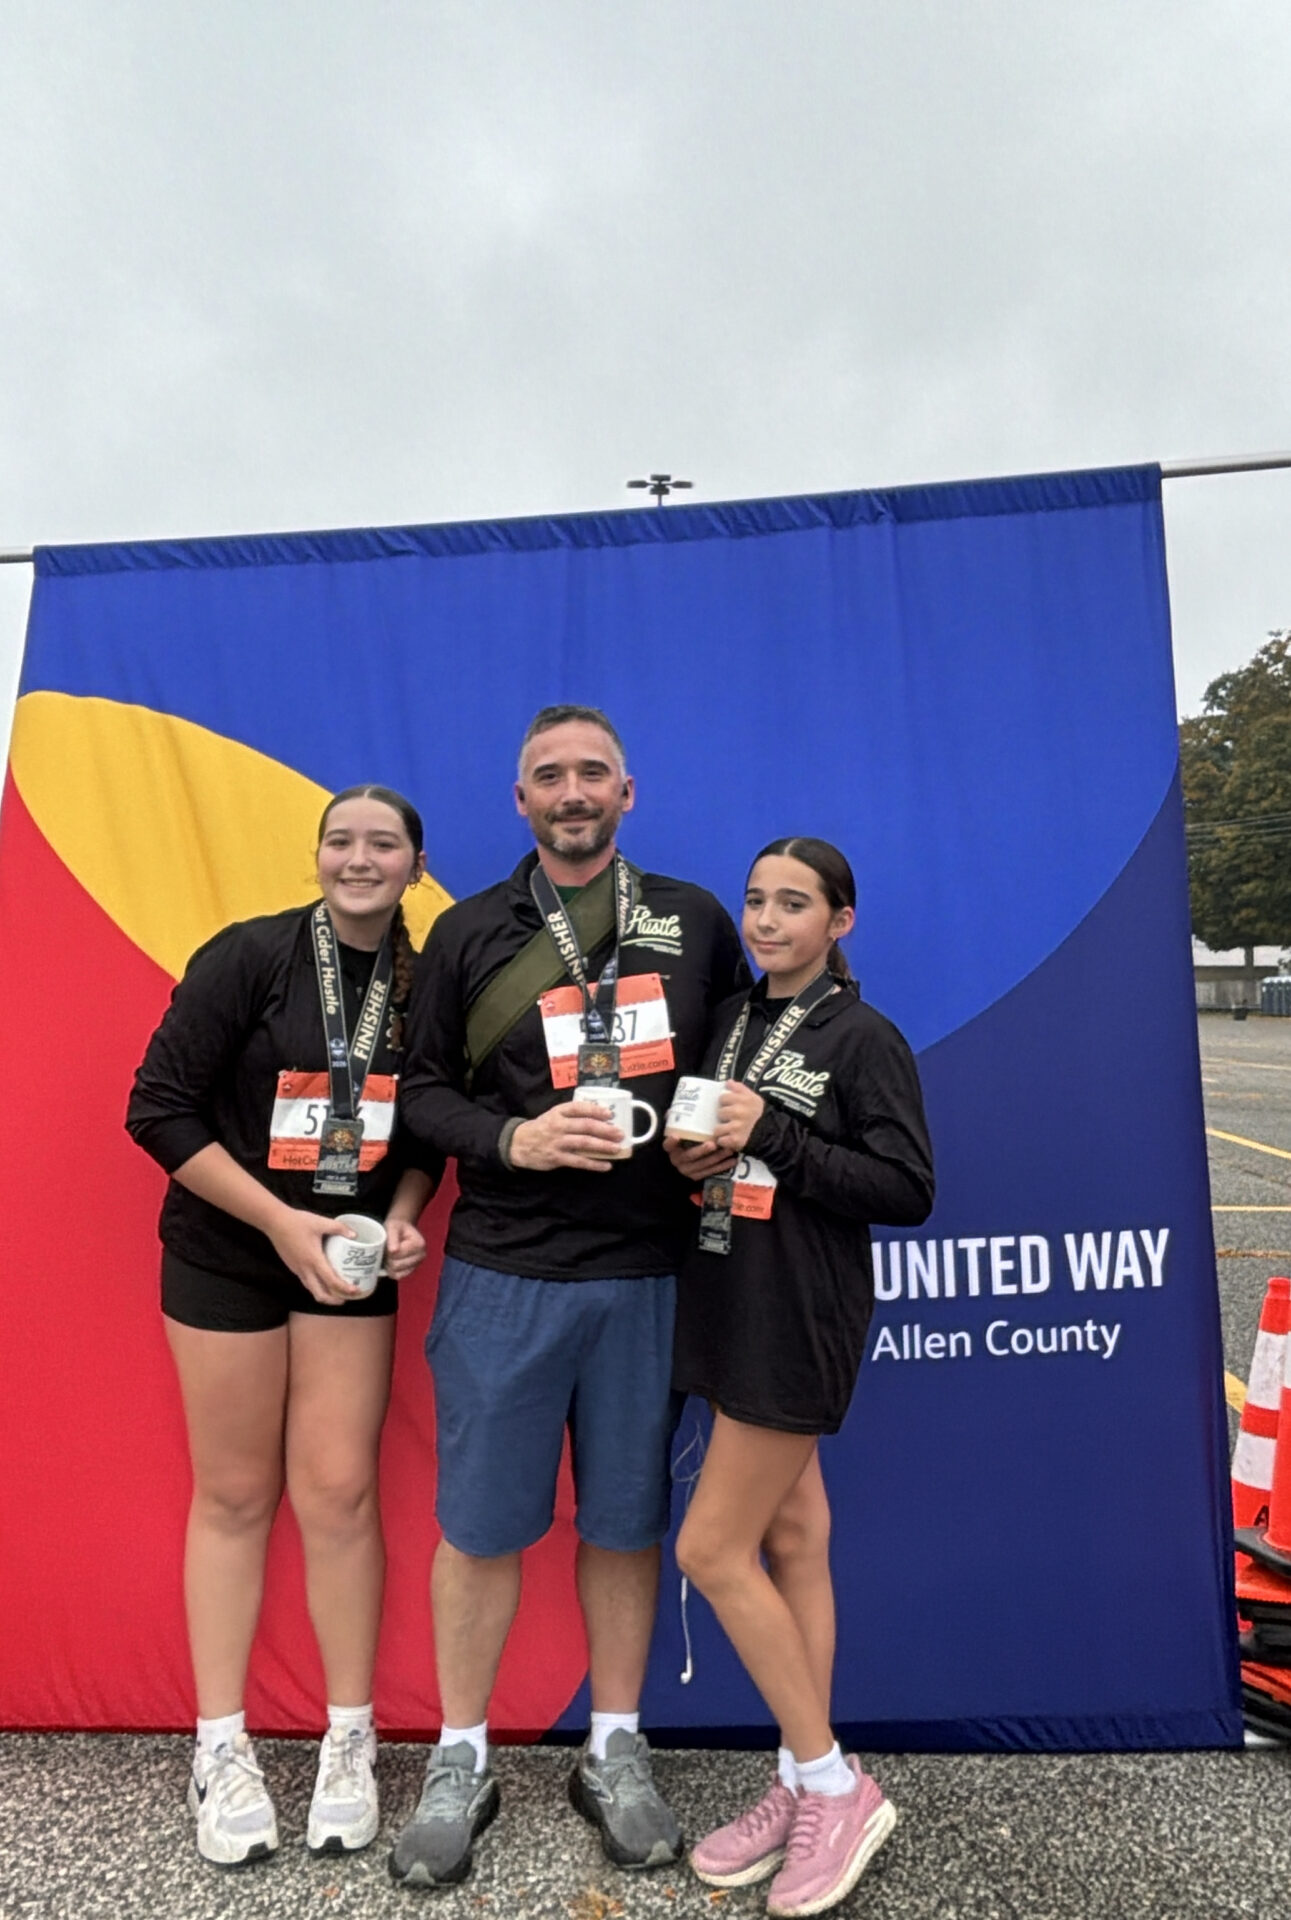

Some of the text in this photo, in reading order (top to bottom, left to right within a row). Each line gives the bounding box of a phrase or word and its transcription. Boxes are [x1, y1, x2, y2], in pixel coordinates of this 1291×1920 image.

[316, 925, 333, 964] Cider
[547, 910, 586, 986] INISHER
[625, 909, 682, 938] Hustle
[321, 967, 340, 1016] Hustle
[353, 980, 387, 1061] FINISHER
[746, 1005, 806, 1082] FINISHER
[762, 1054, 831, 1098] Hustle
[871, 1228, 1170, 1302] UNITED WAY
[871, 1319, 1122, 1361] Allen County
